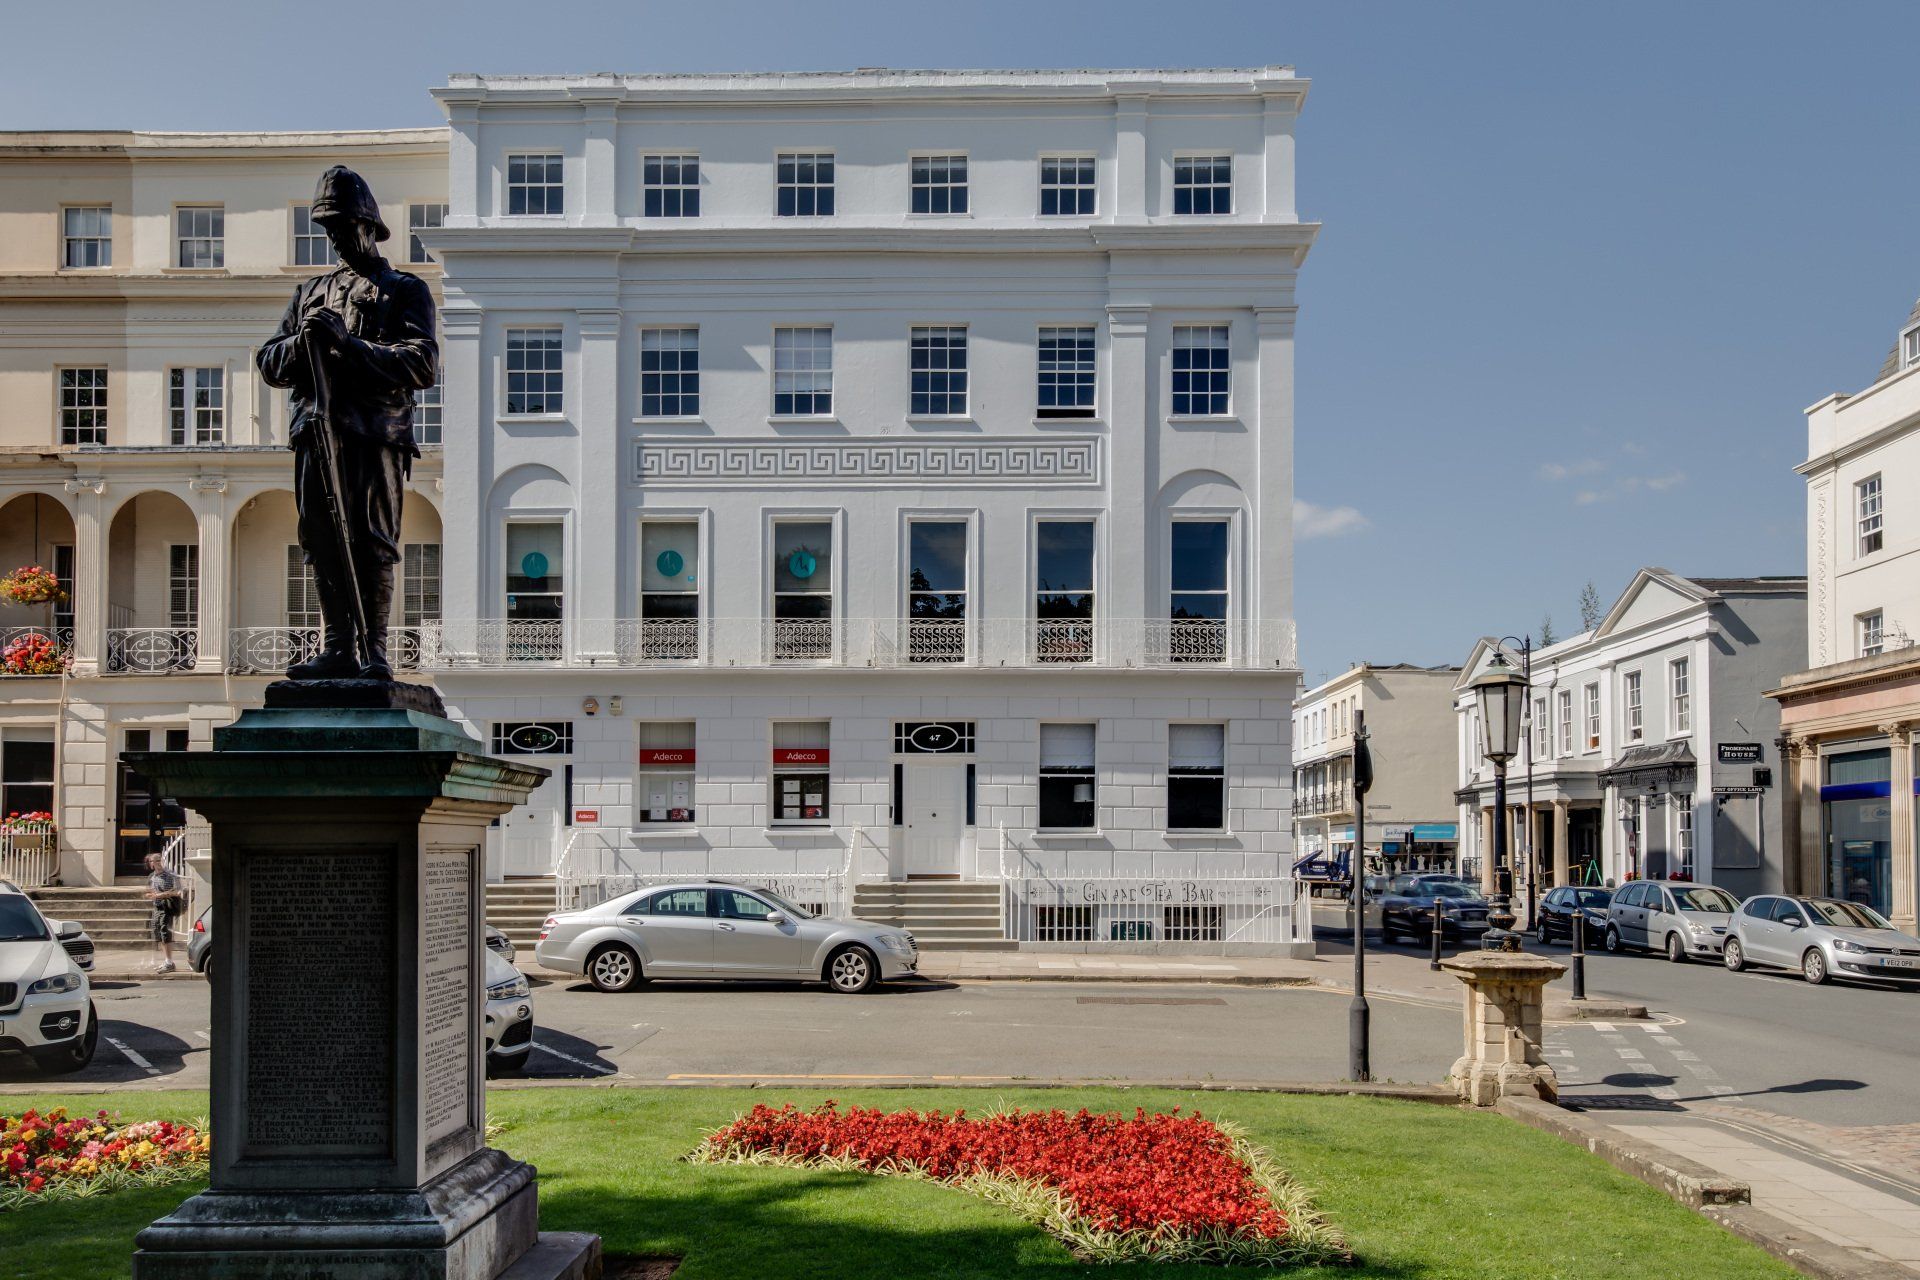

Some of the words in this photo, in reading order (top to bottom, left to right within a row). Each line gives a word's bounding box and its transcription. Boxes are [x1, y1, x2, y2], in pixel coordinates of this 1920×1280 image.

[653, 752, 683, 761] Adecco
[786, 752, 816, 760] Adecco
[1182, 881, 1214, 902] BAR
[325, 1255, 384, 1264] HAMILTON
